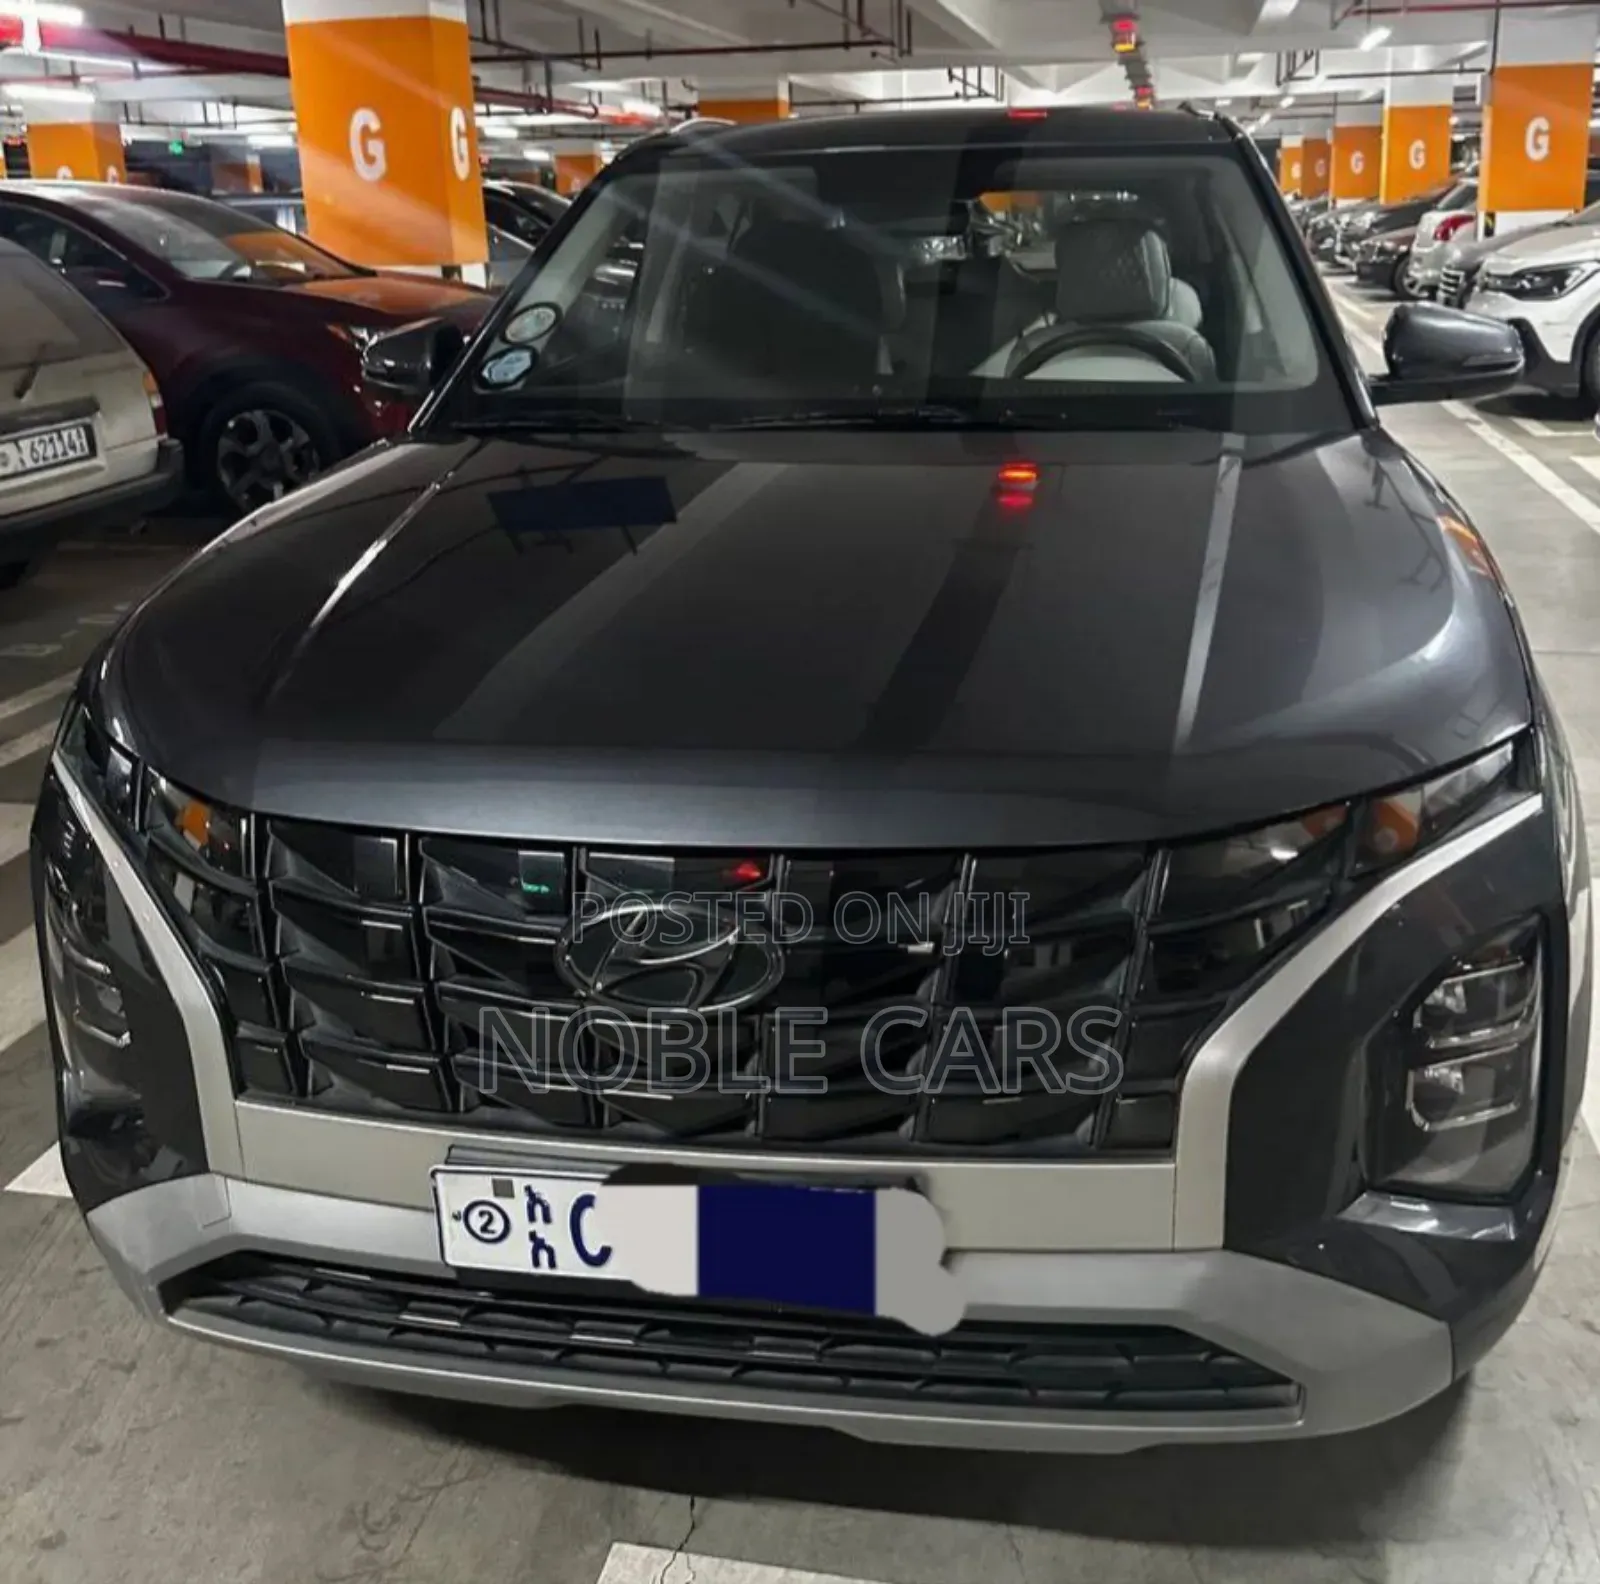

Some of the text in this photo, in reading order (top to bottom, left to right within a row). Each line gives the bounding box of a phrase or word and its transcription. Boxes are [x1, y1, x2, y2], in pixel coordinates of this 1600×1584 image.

[350, 108, 386, 181] G
[452, 107, 470, 181] G
[1409, 140, 1426, 170] G
[1525, 116, 1549, 161] G
